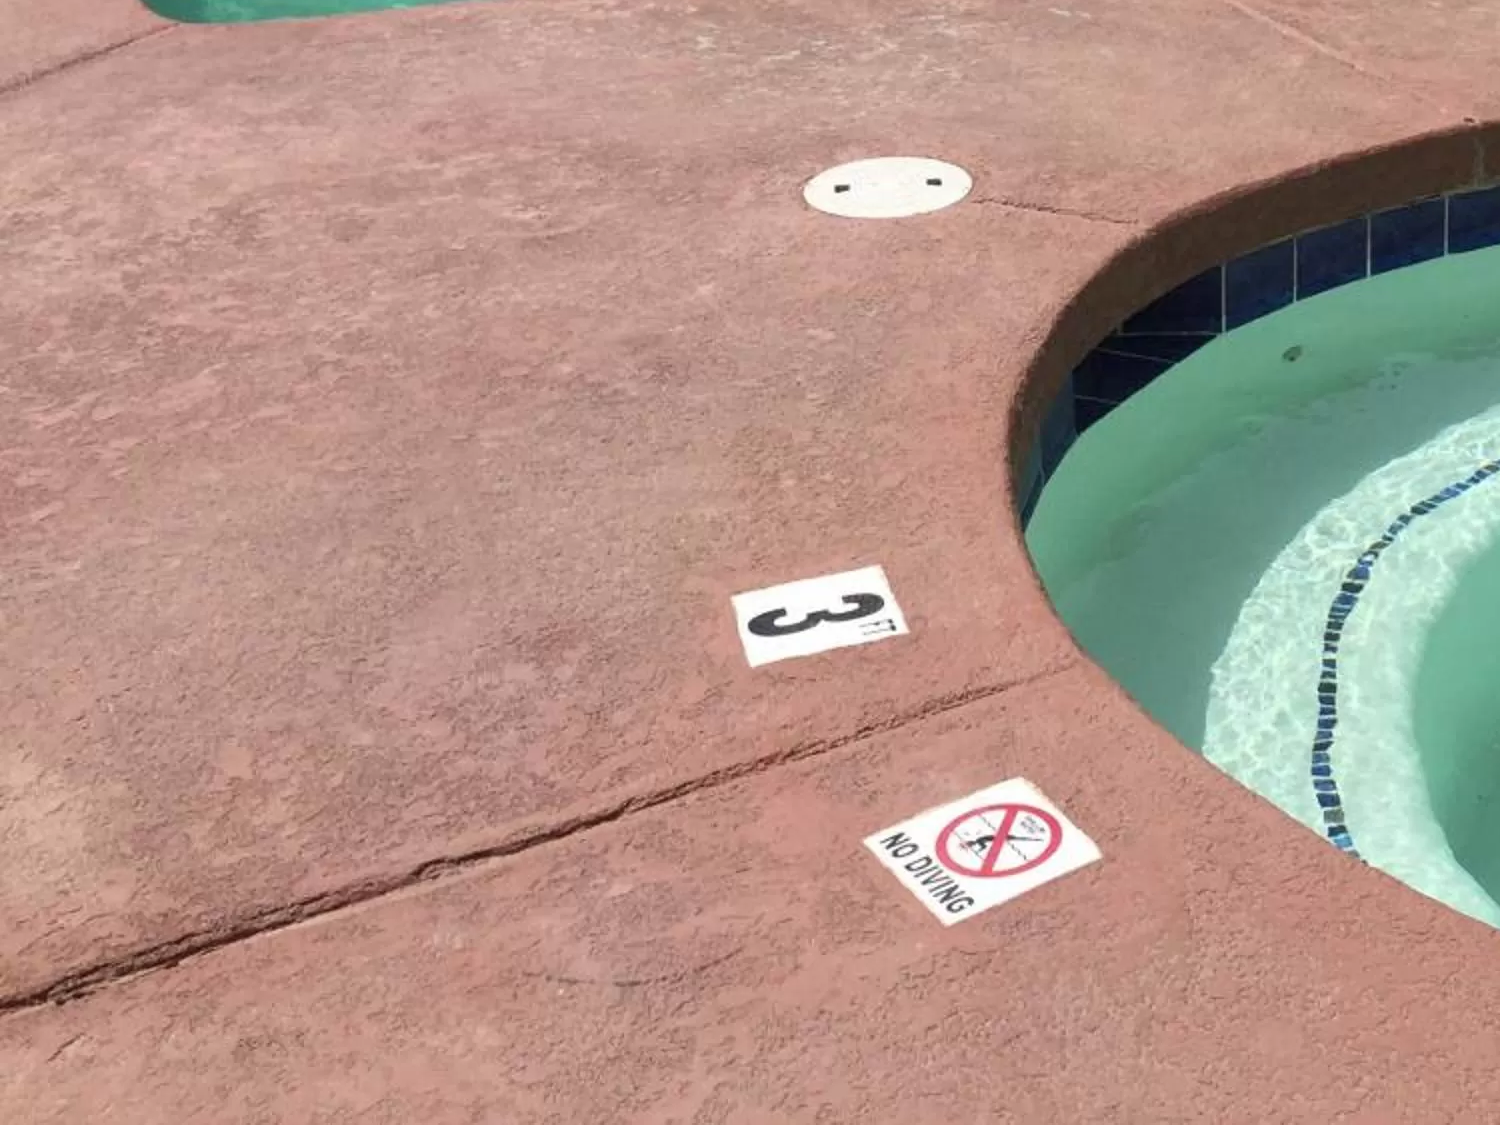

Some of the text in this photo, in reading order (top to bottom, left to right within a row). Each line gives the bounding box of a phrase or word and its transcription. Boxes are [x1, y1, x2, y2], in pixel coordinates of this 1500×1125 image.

[748, 593, 885, 637] 3
[880, 832, 975, 913] NO DIVING
